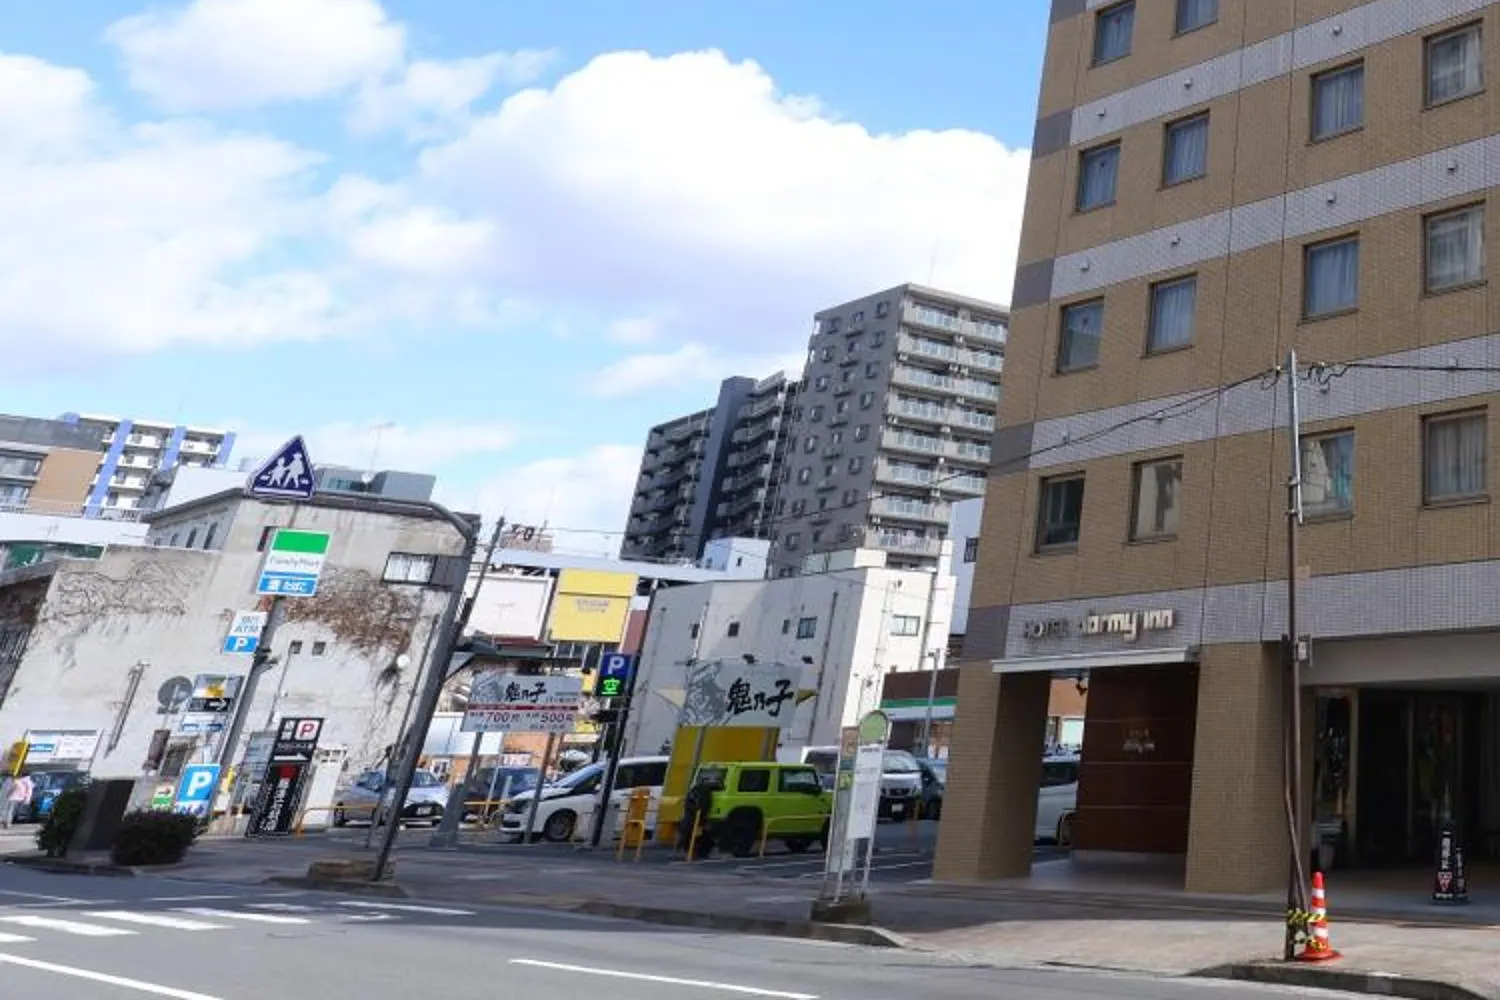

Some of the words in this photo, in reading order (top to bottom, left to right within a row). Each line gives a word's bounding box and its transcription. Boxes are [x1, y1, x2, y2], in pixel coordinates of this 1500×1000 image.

[1143, 607, 1174, 631] inn
[234, 637, 248, 650] P
[608, 656, 625, 674] P
[299, 723, 315, 737] P
[187, 771, 213, 797] P
